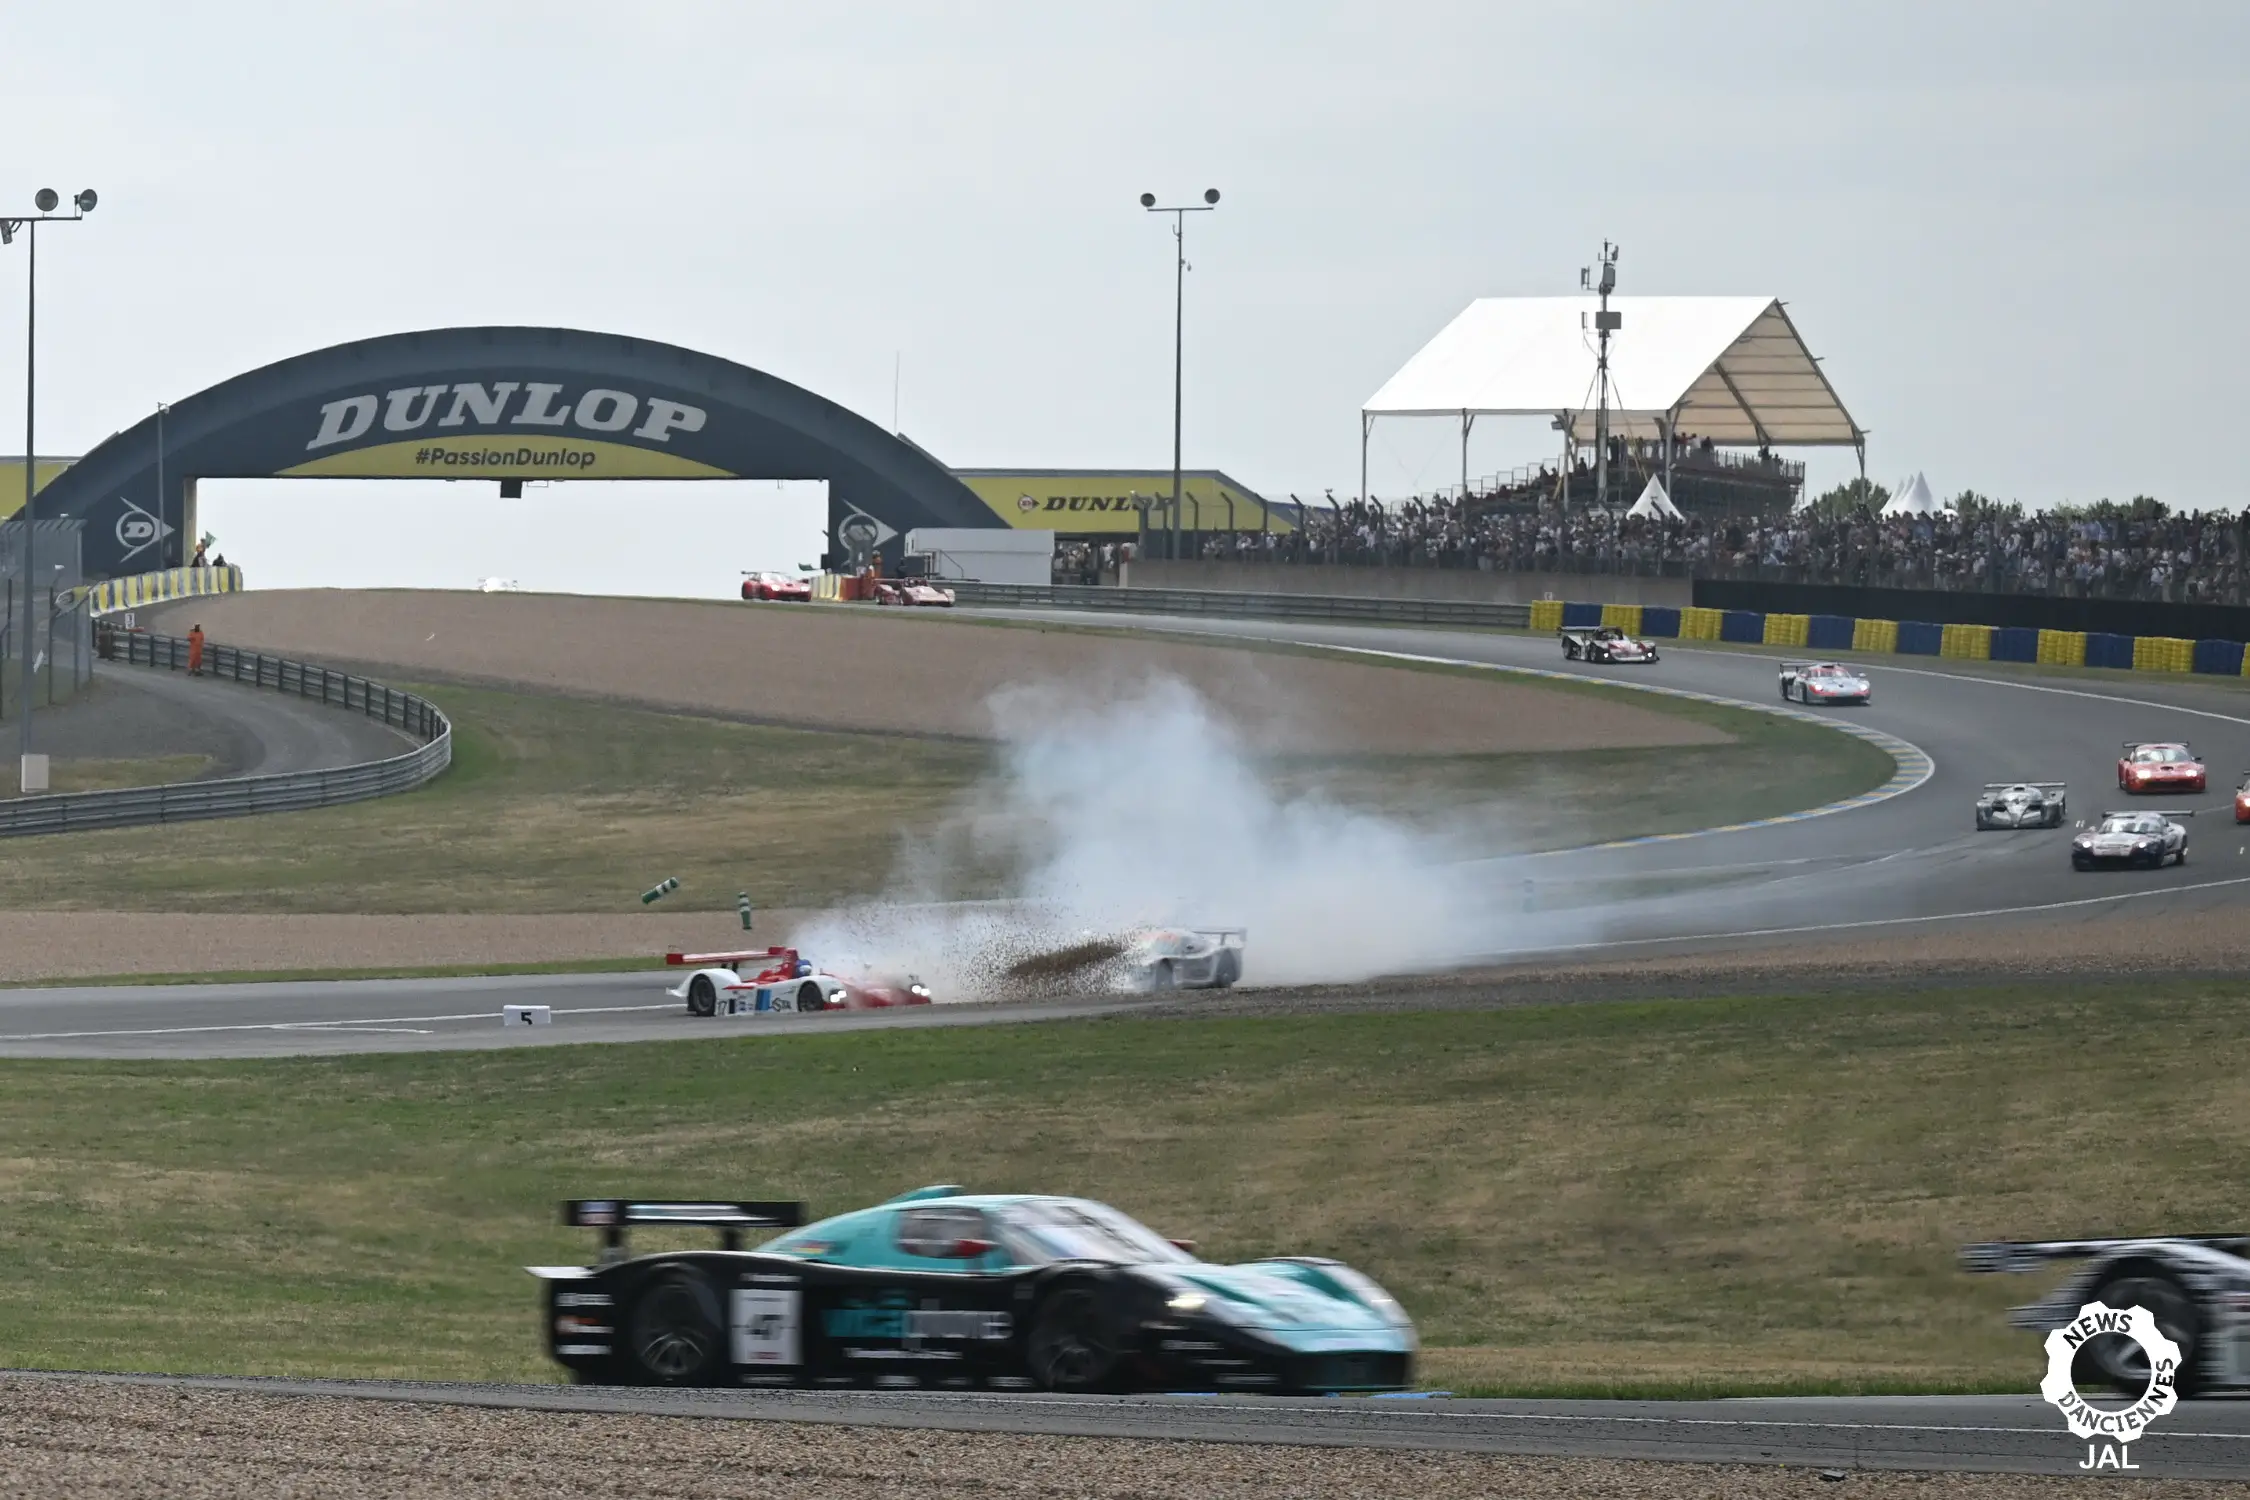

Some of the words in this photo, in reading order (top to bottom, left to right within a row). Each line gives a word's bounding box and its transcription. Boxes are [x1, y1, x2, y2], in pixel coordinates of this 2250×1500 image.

[305, 381, 708, 452] DUNLOP
[415, 447, 596, 470] #PassionDunlop
[520, 1011, 533, 1026] 5
